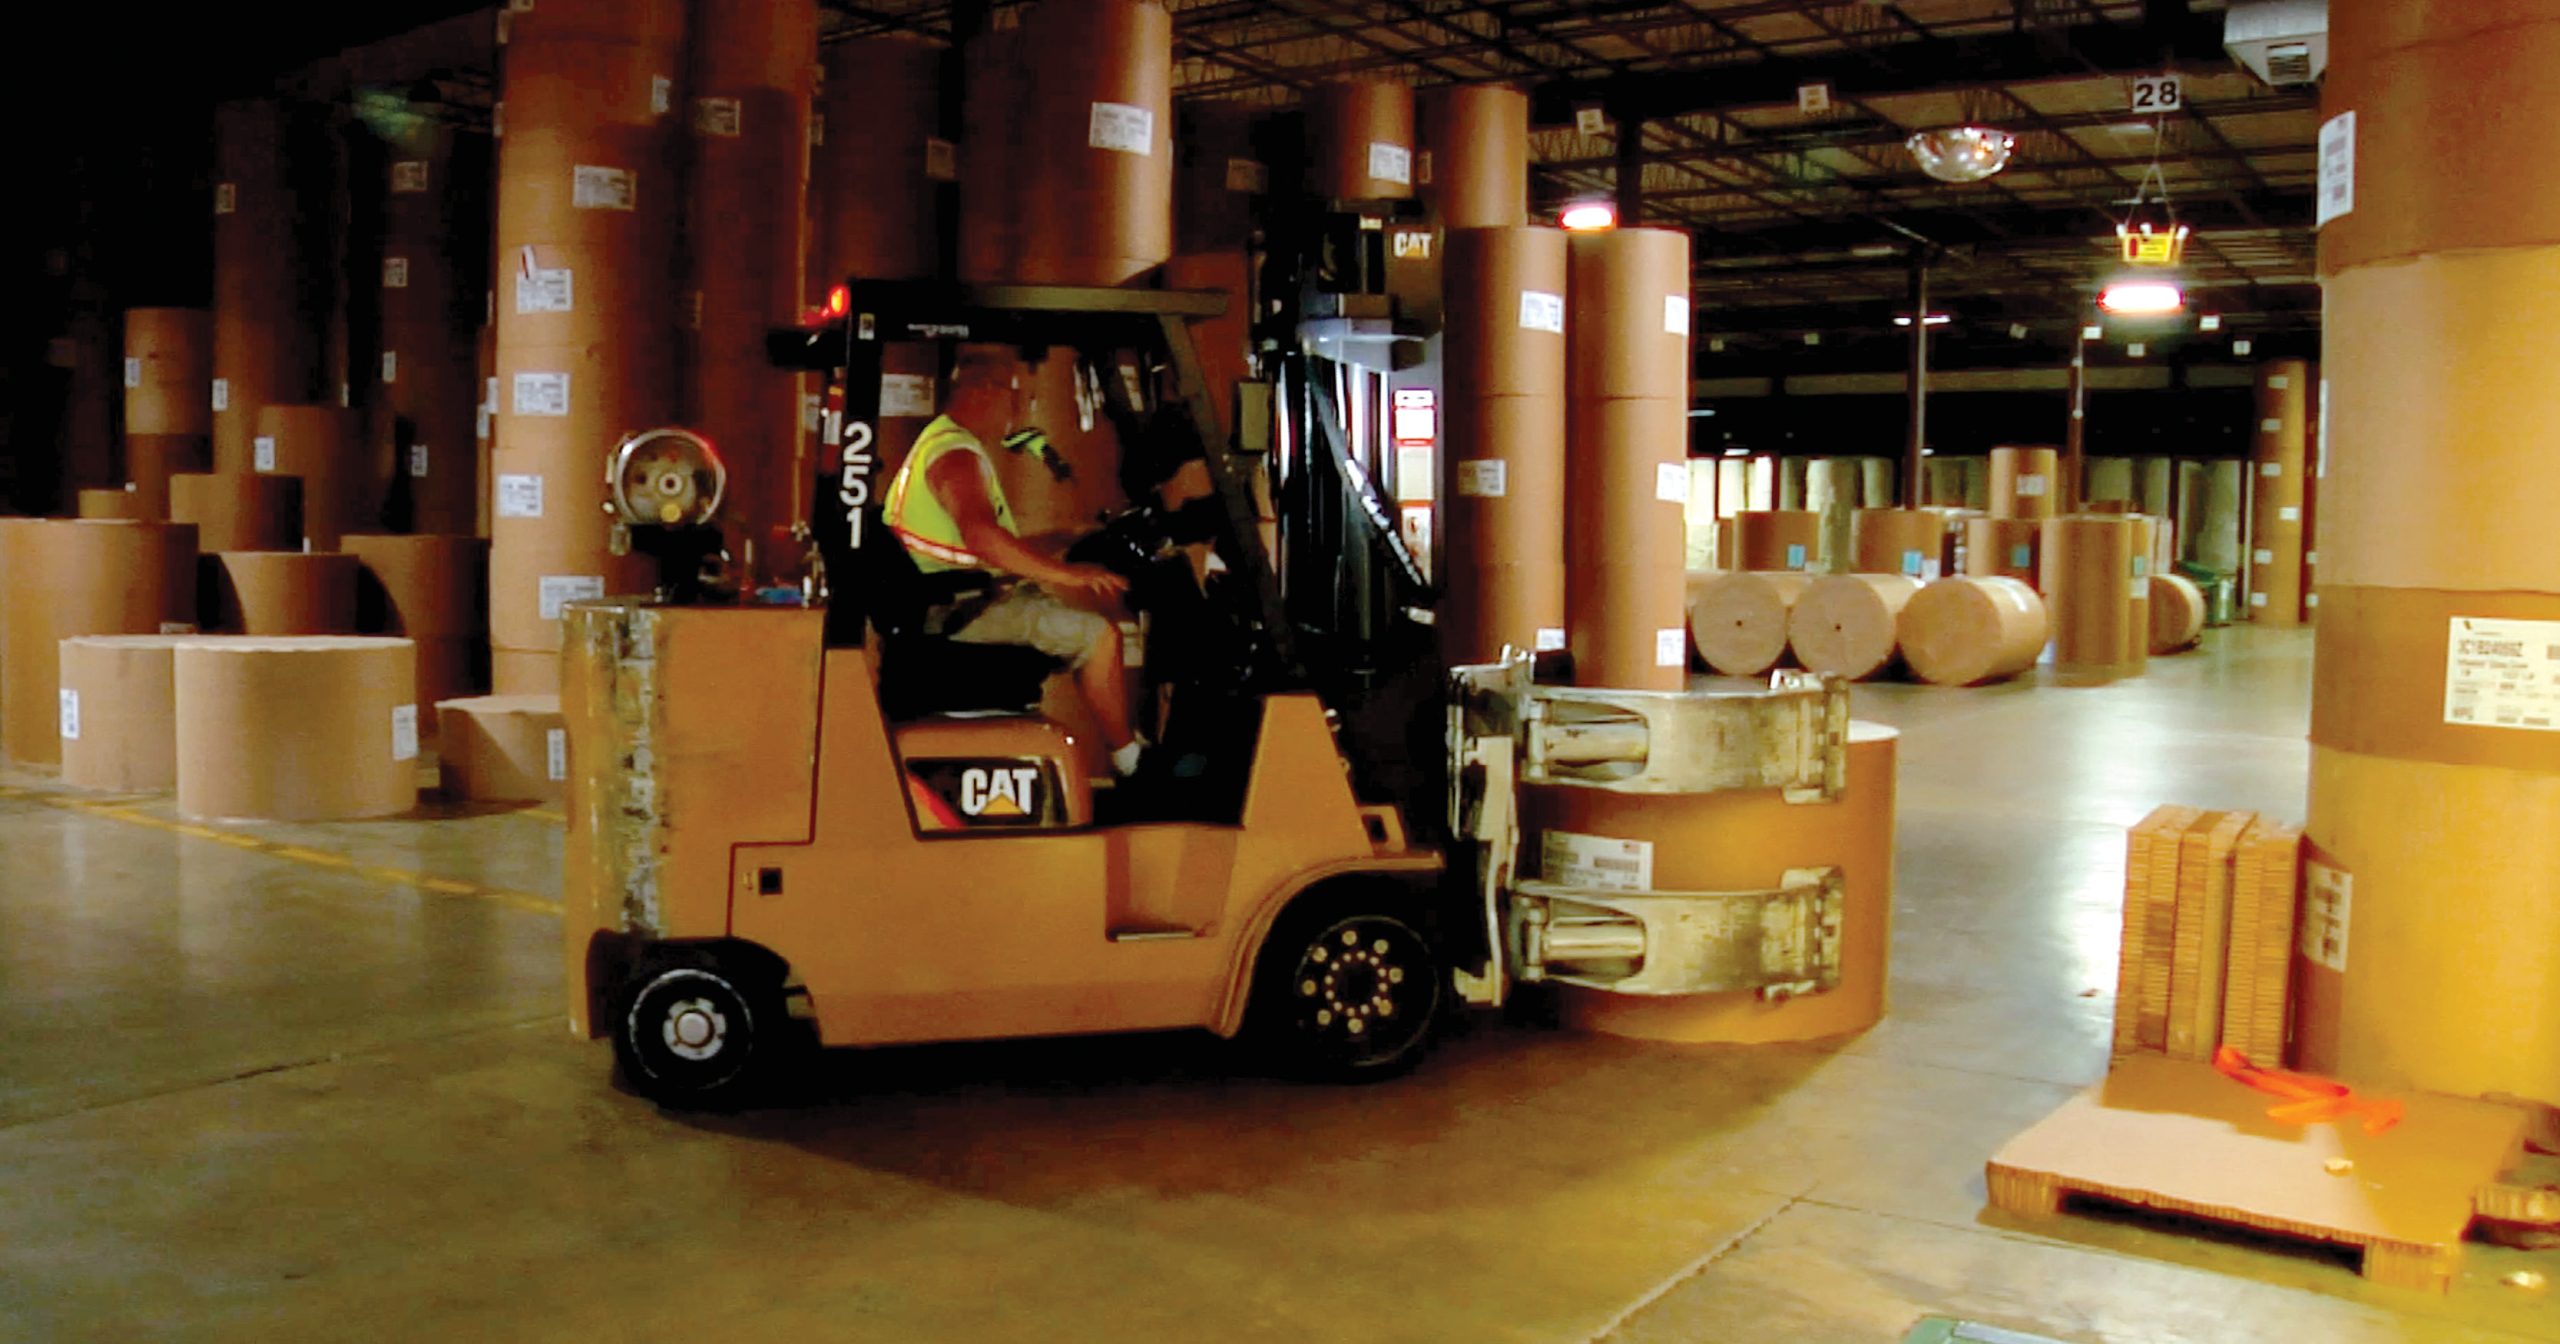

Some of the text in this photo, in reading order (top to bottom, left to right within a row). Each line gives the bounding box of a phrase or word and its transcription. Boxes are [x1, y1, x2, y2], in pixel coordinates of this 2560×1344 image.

[2136, 81, 2176, 107] 28
[1394, 232, 1432, 258] CAT
[840, 421, 872, 549] 251
[961, 768, 1037, 815] CAT
